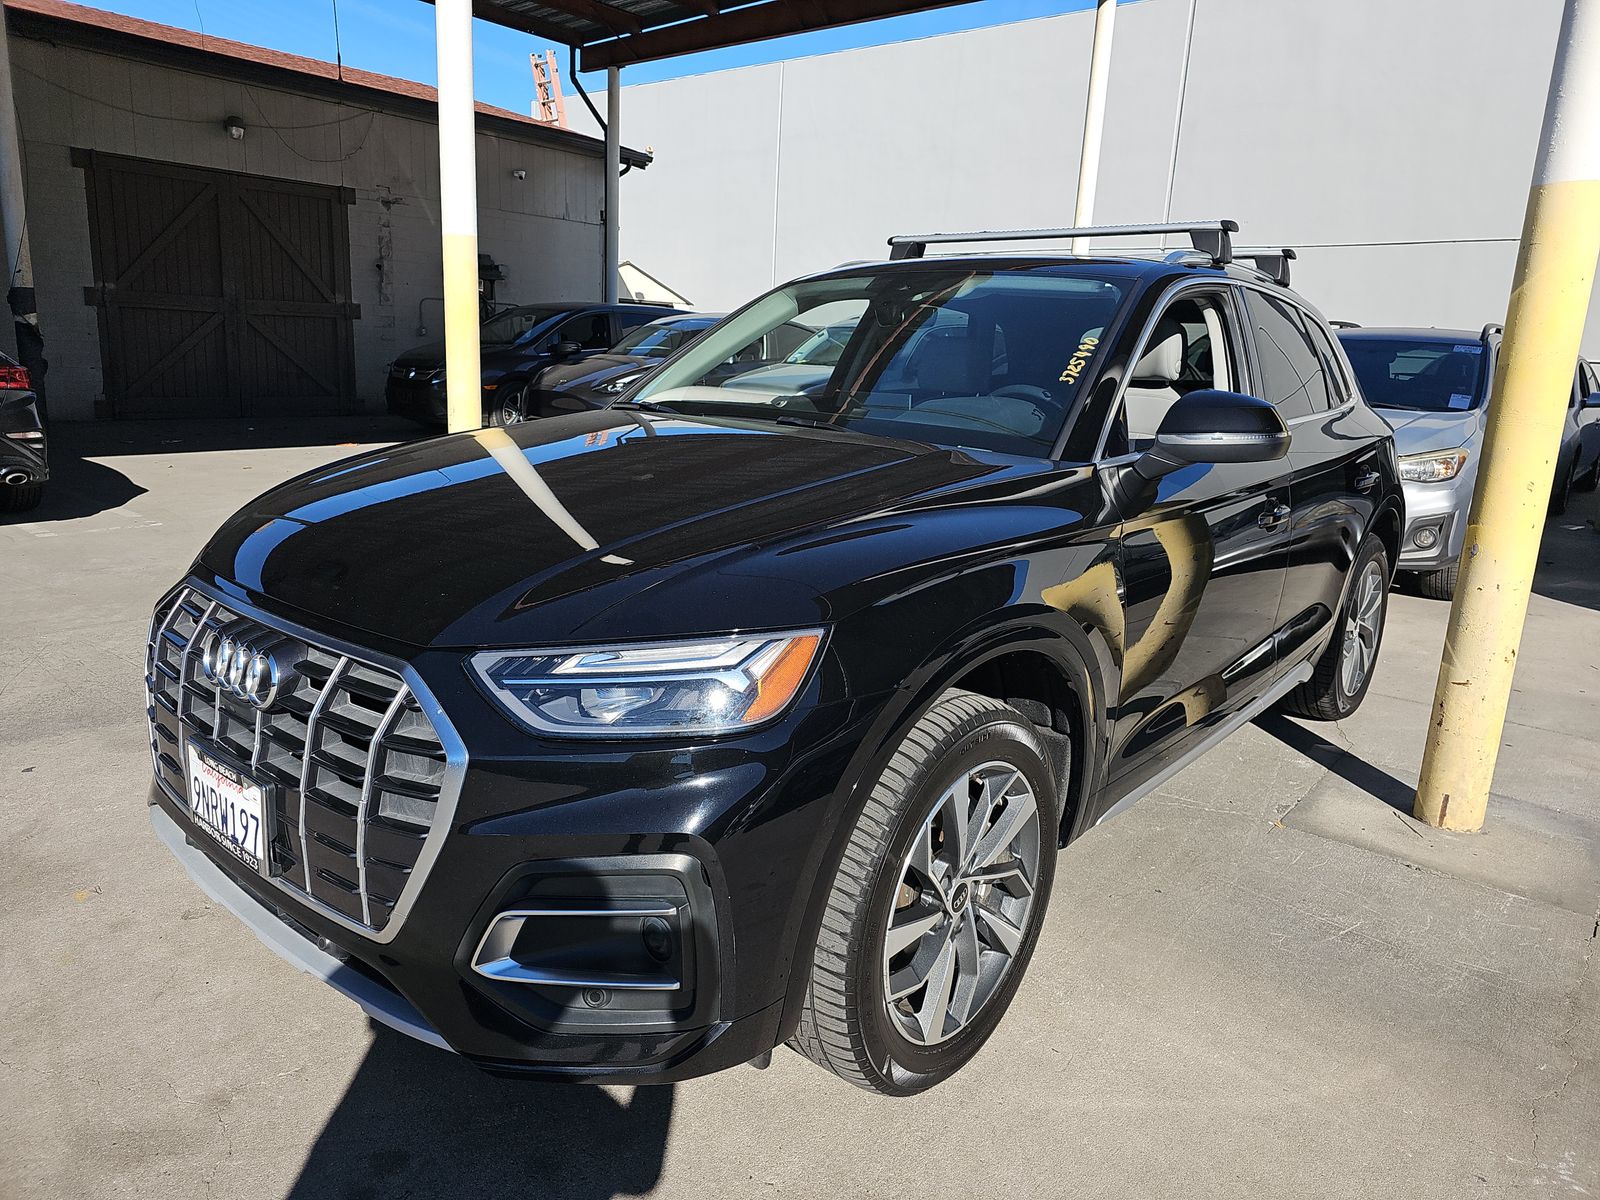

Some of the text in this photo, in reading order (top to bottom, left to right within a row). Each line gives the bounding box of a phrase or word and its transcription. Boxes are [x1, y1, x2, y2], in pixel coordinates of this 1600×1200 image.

[1059, 337, 1099, 384] 3725490
[204, 755, 237, 782] LONG BEACH
[193, 776, 259, 855] 9NRW197
[194, 815, 259, 870] HARBOR SINCE 1923
